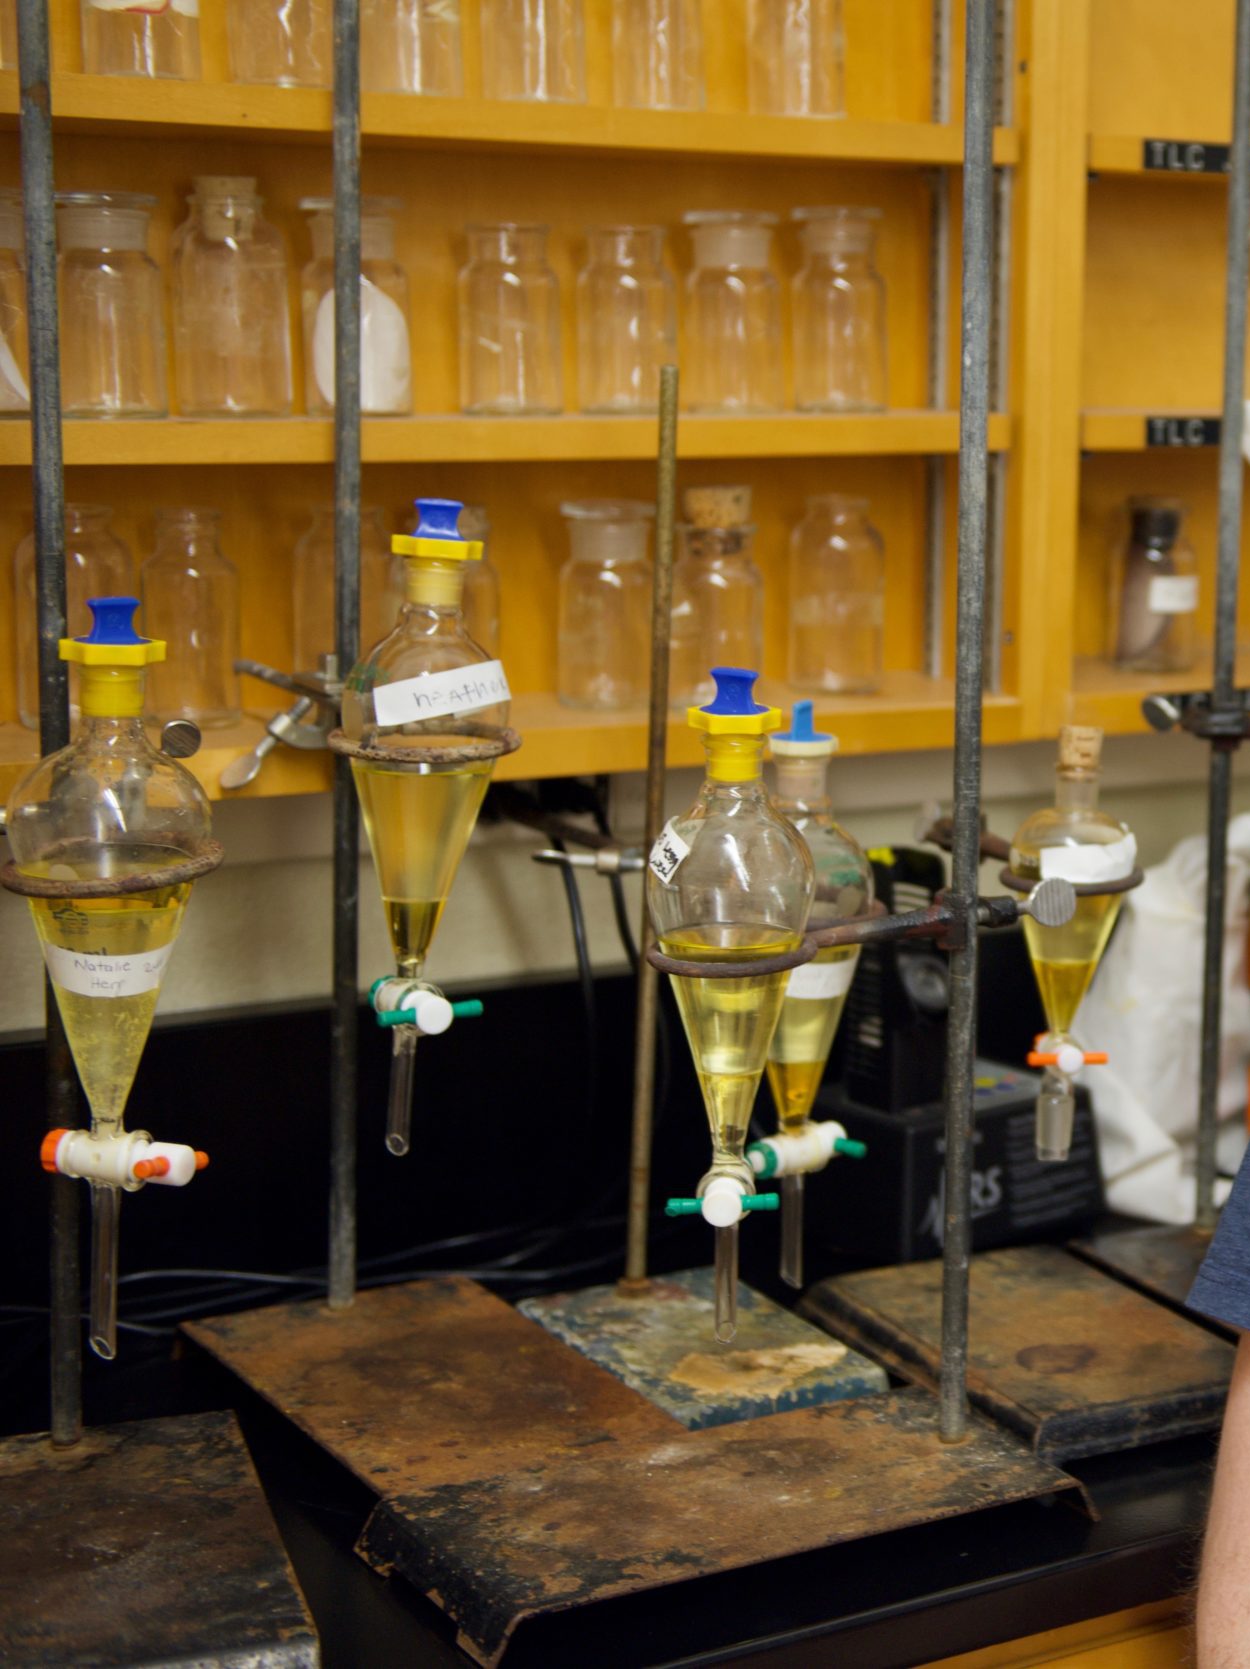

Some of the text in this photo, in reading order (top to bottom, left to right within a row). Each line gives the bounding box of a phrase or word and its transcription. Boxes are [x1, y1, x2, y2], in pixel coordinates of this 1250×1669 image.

[1151, 141, 1205, 169] TLC
[1152, 419, 1205, 444] TLC
[74, 958, 132, 973] Natalie
